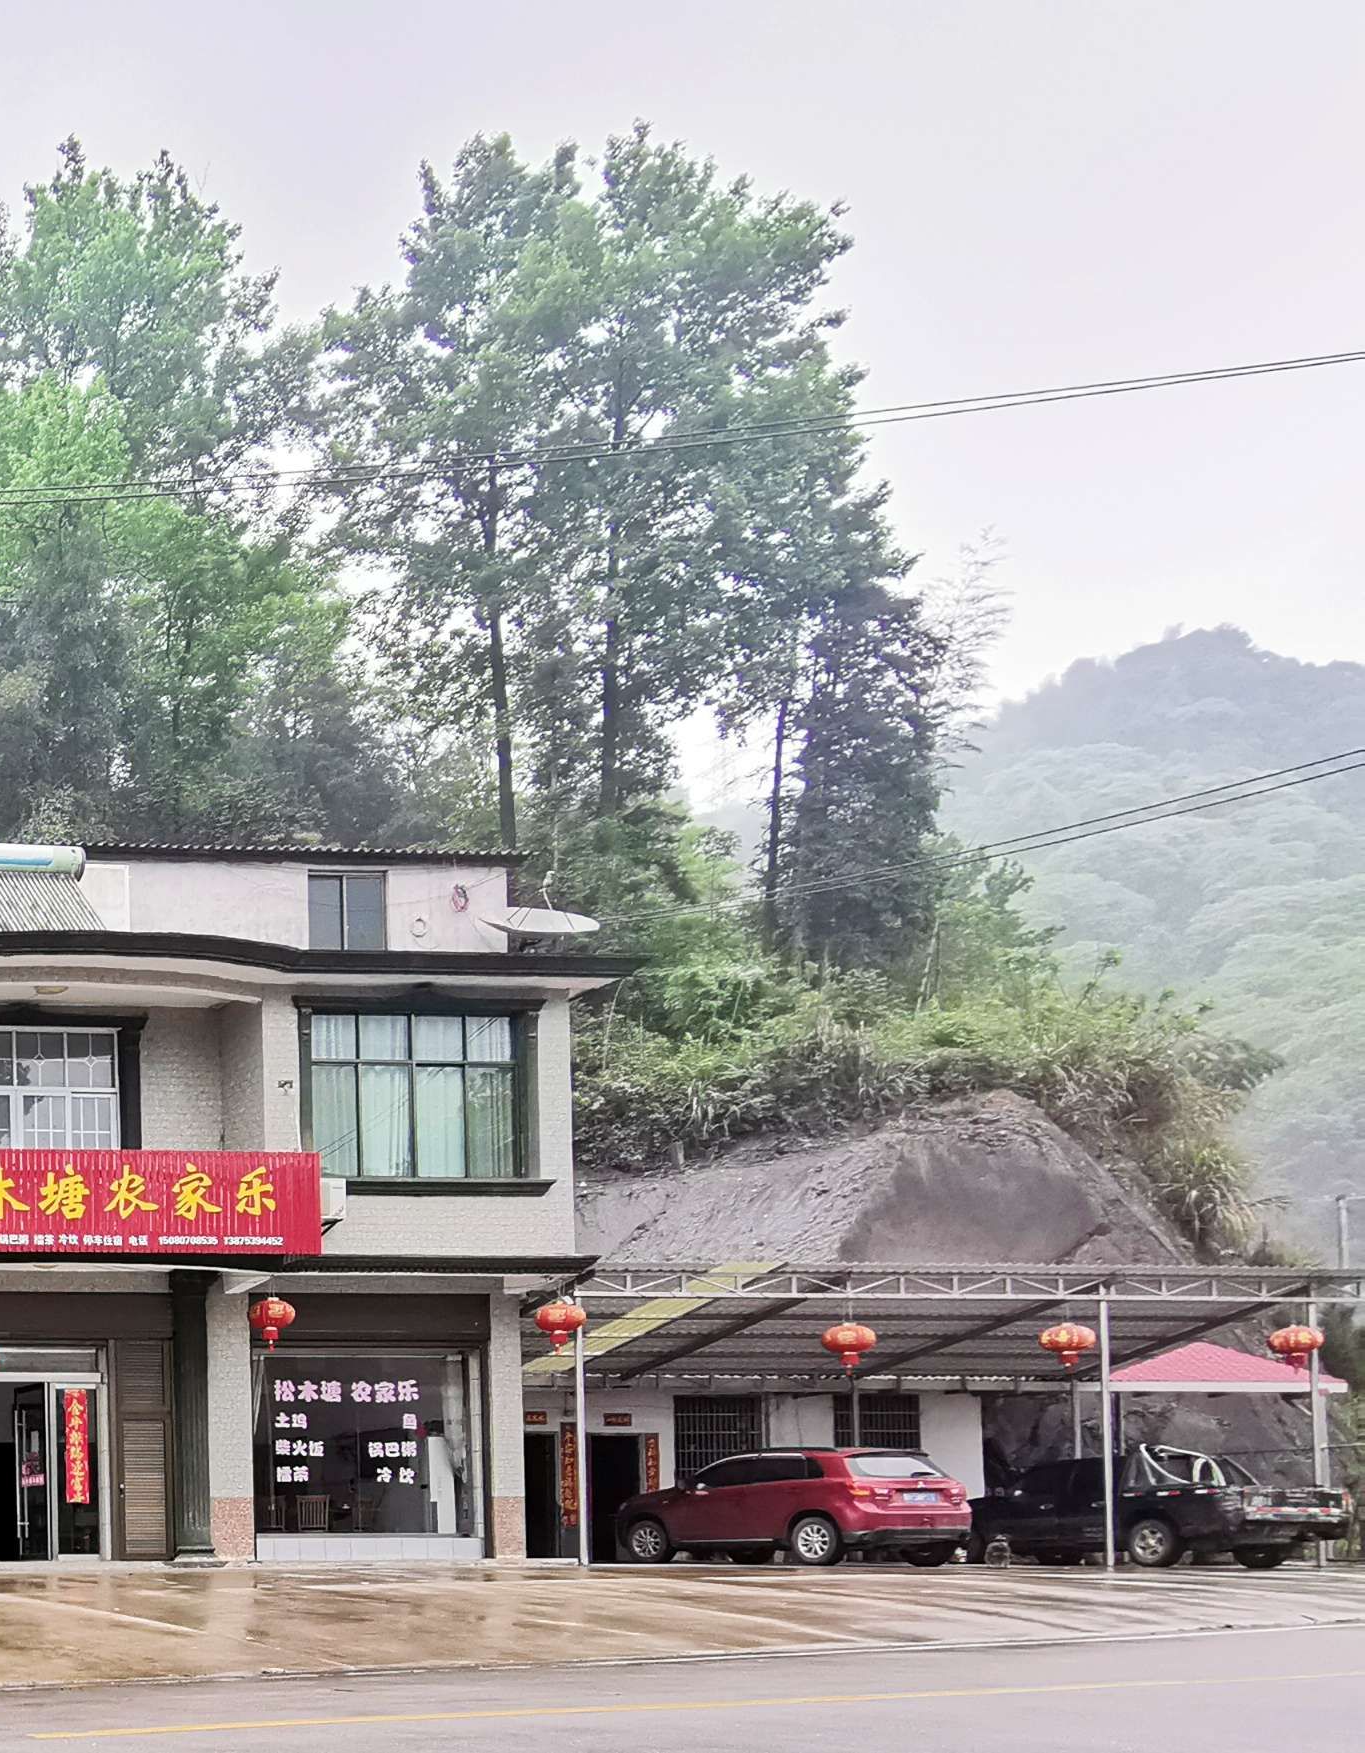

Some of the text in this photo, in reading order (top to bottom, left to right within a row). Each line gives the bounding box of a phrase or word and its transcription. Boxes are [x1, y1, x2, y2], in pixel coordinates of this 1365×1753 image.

[273, 1379, 419, 1403] 松木塘 农家乐
[274, 1411, 308, 1429] 土鸡
[275, 1439, 325, 1457] 柴火饭
[368, 1441, 418, 1458] 锅巴粥
[376, 1467, 415, 1485] 冷饮
